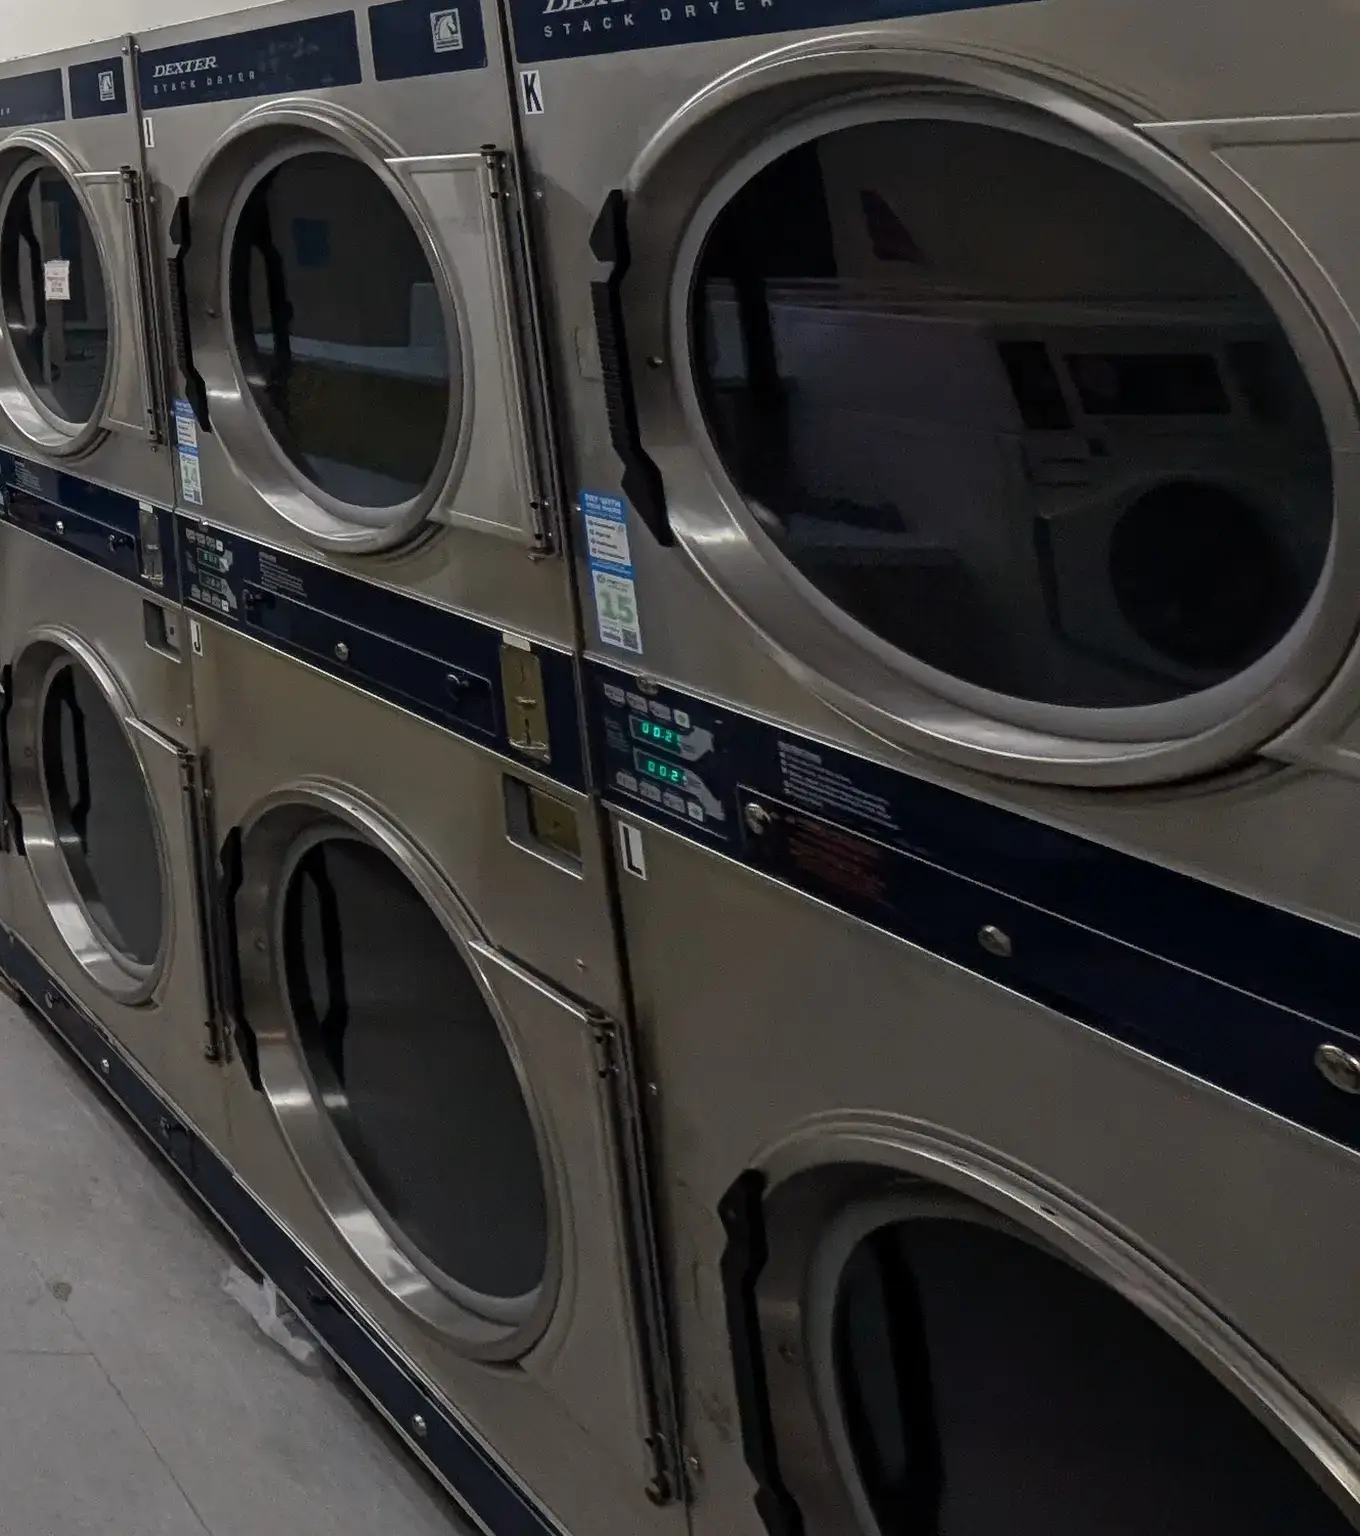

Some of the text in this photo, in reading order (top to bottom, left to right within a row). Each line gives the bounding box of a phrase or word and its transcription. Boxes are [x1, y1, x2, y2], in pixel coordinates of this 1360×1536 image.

[544, 13, 635, 38] STACK
[152, 55, 218, 78] DEXTER
[523, 73, 543, 113] K
[598, 591, 635, 624] 15
[193, 624, 201, 653] J
[622, 824, 644, 877] L
